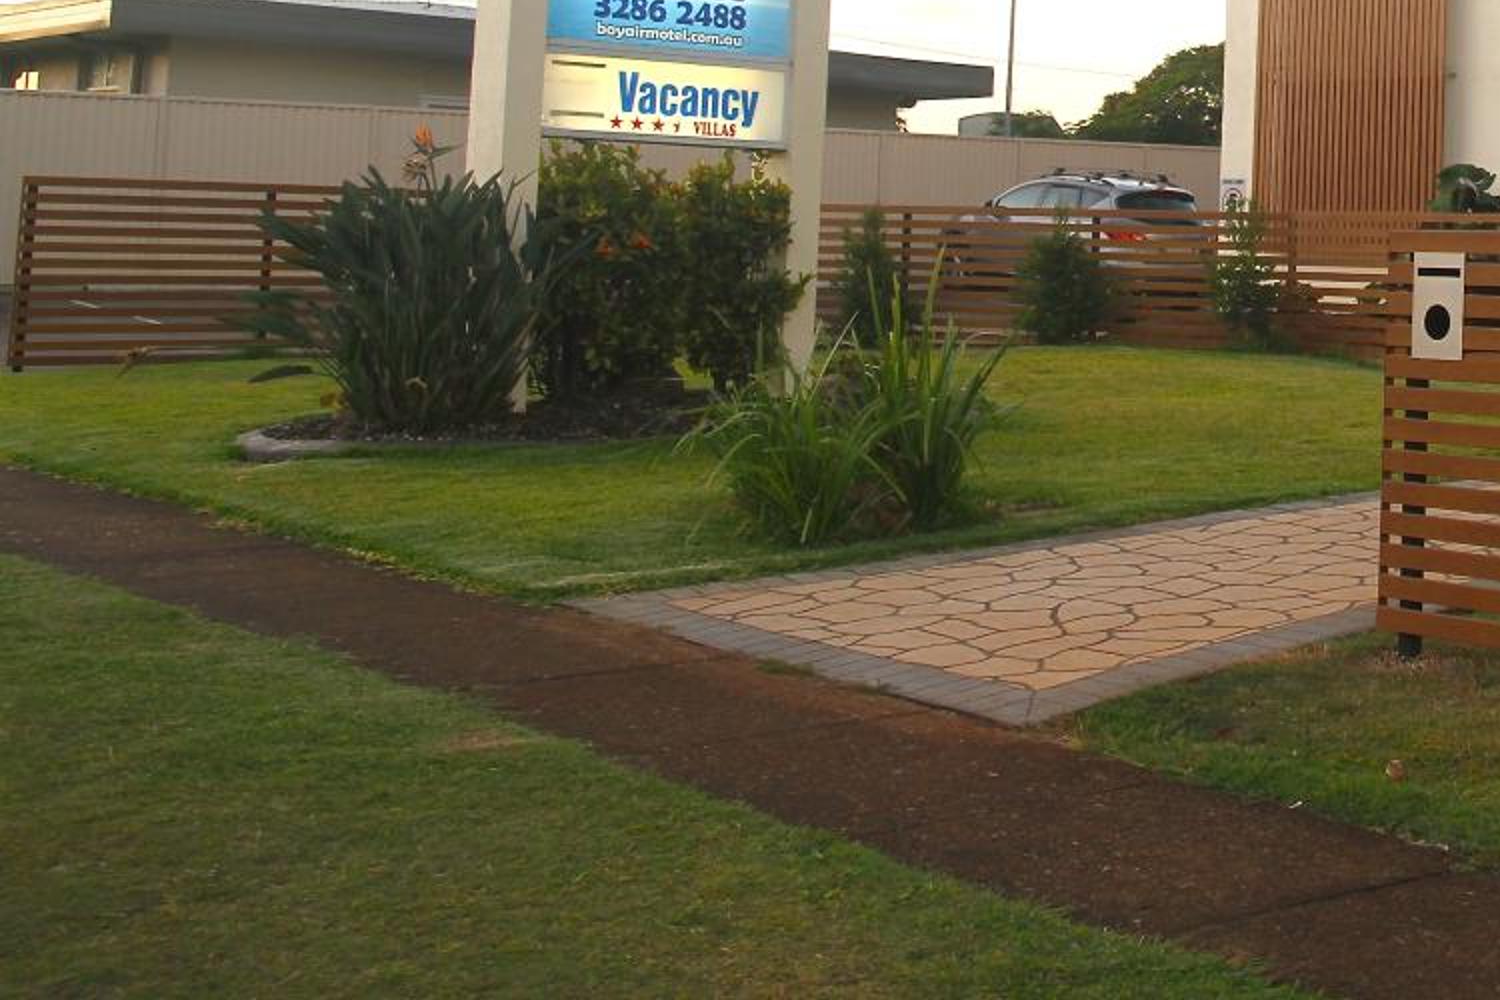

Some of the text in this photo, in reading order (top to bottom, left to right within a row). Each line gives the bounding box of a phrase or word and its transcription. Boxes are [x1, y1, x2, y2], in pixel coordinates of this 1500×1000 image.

[676, 1, 746, 30] 2488
[596, 21, 743, 46] bayairmotel.com.au
[619, 71, 759, 128] Vacancy
[694, 122, 736, 137] VILLAS
